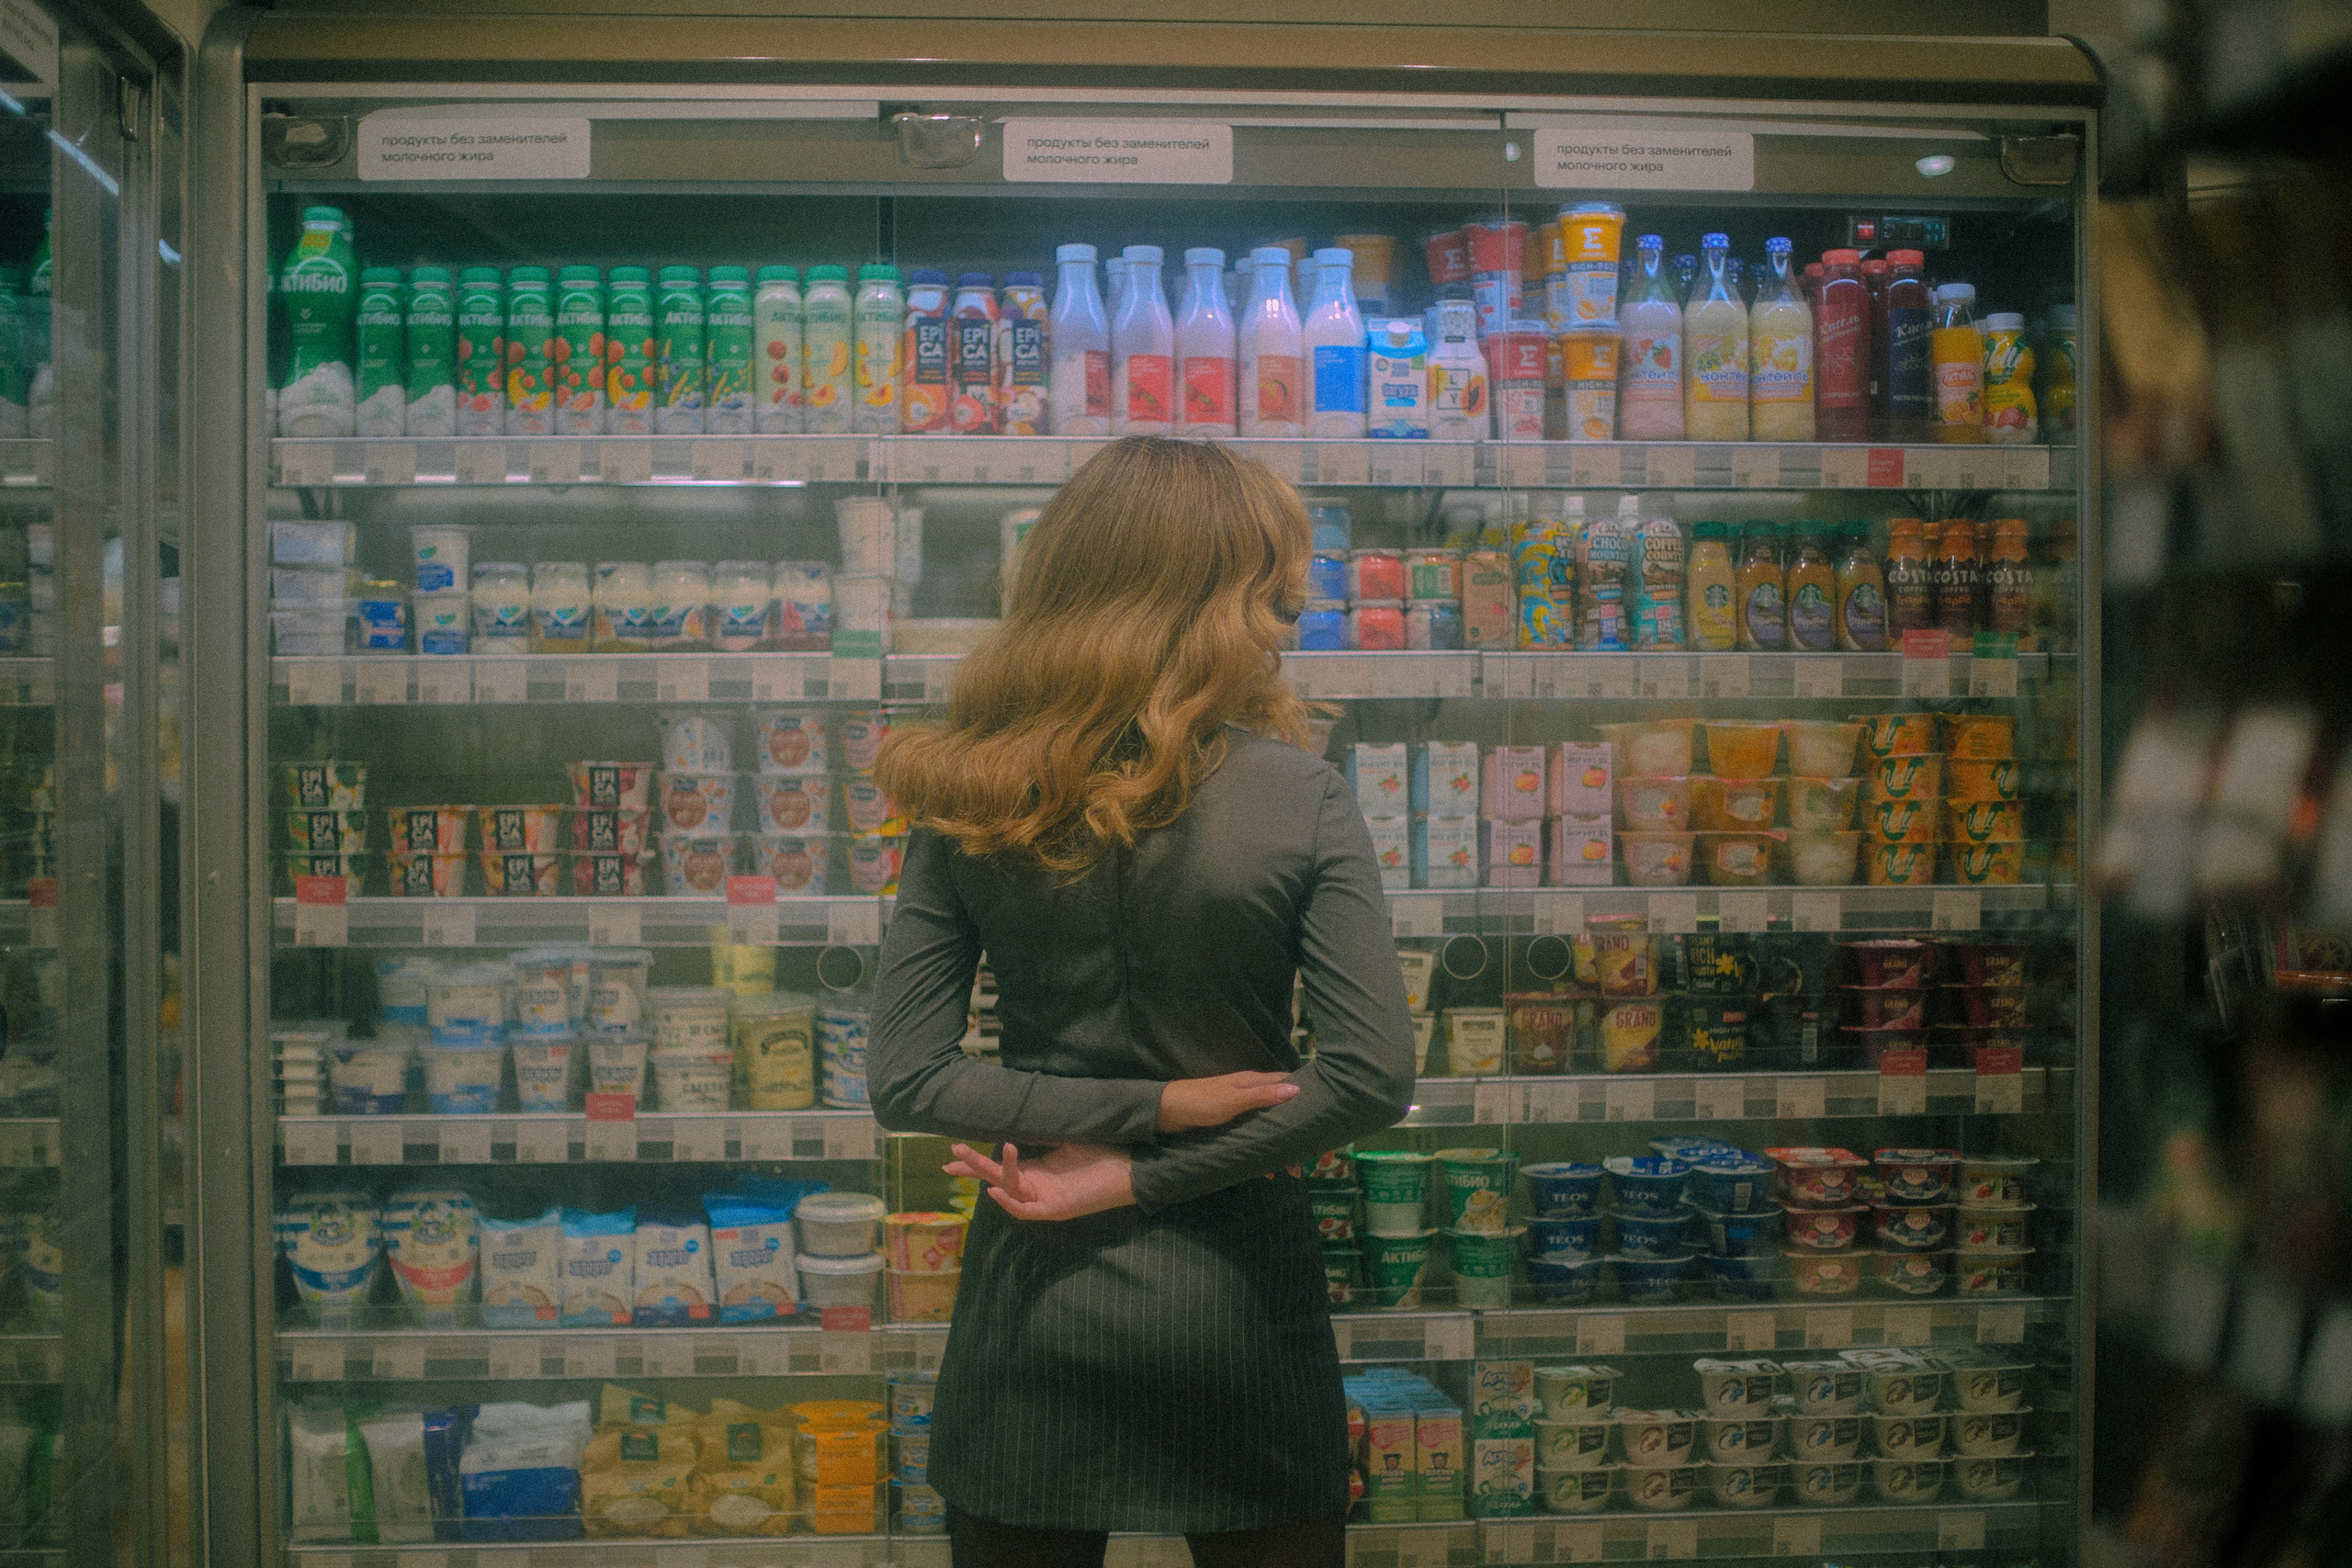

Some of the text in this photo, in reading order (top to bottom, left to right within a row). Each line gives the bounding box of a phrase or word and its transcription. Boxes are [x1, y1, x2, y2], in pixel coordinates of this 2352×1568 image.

[381, 131, 567, 148] продукты без заменителей
[1027, 137, 1210, 151] продукты без заменителей
[1557, 144, 1732, 157] продукты без заменителей
[382, 151, 494, 164] молочного жира
[1027, 154, 1138, 166] молочного жира
[1557, 161, 1664, 173] молочного жира
[1934, 570, 1979, 585] COSTA
[1986, 570, 2034, 585] COSTA
